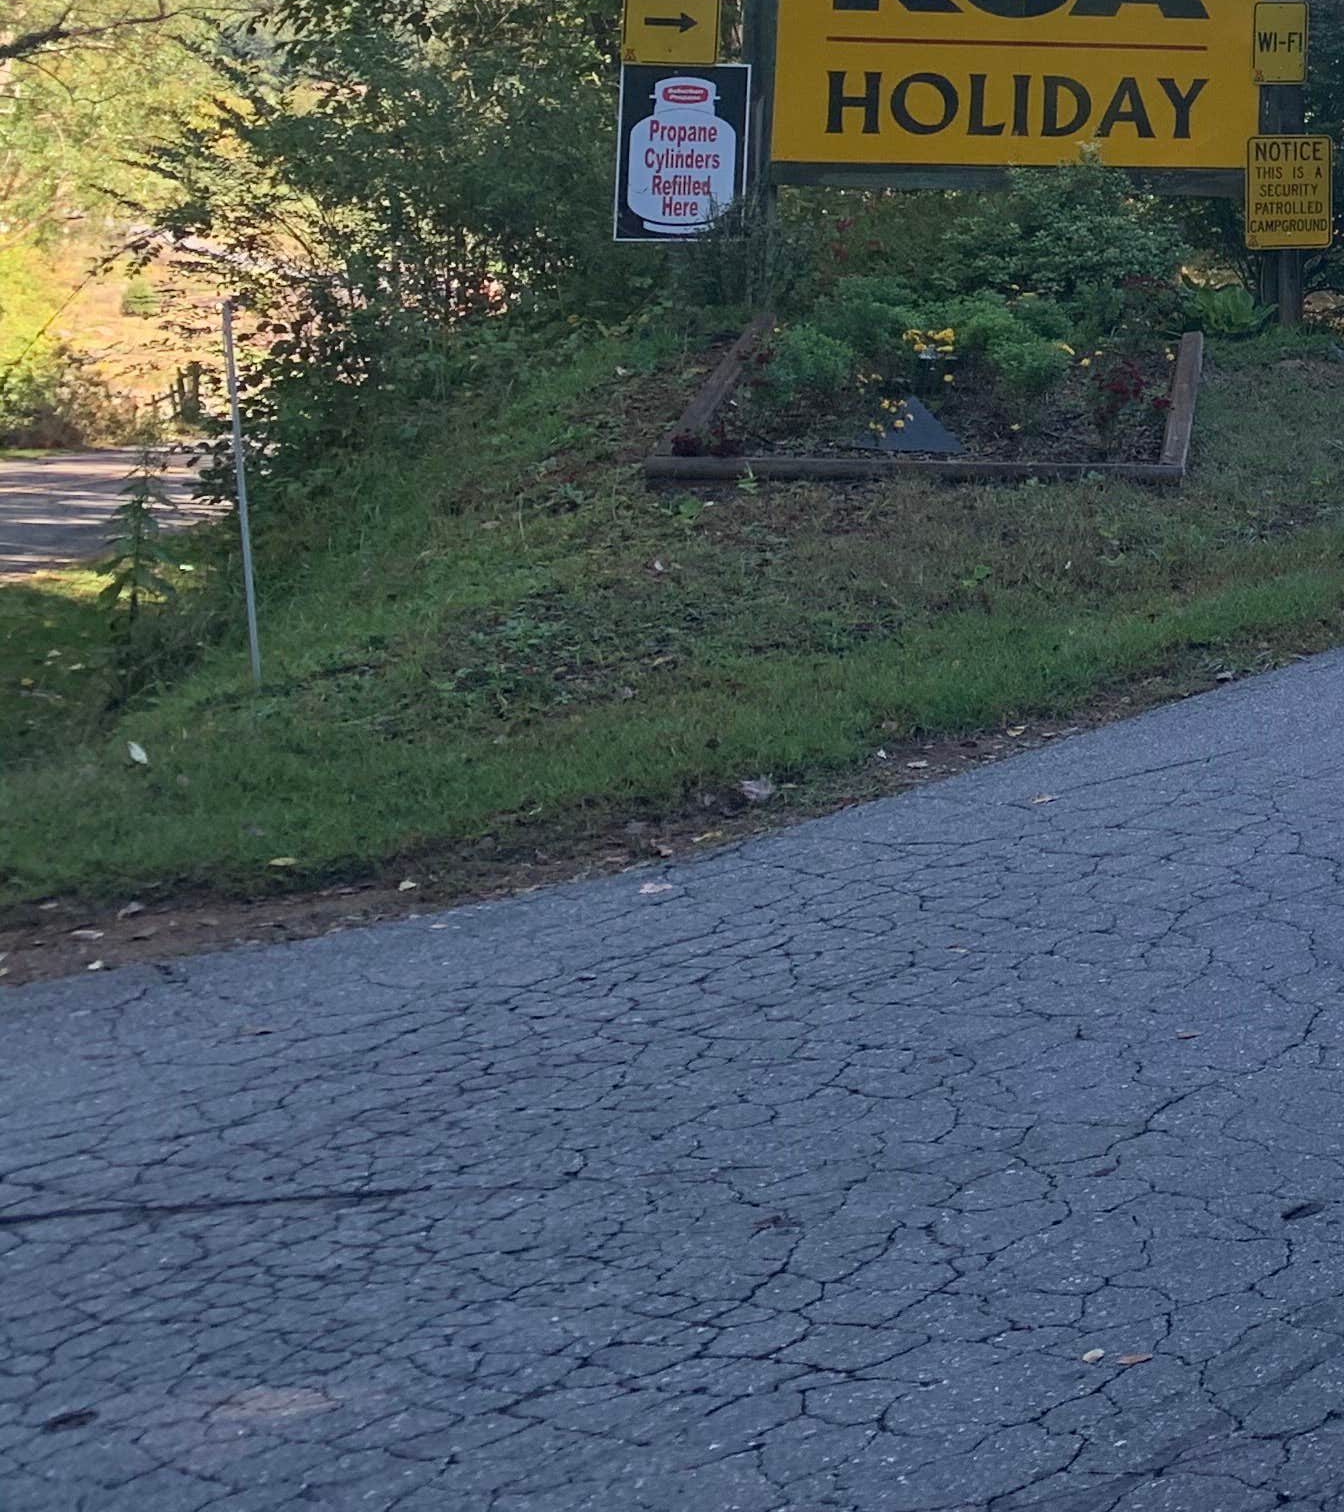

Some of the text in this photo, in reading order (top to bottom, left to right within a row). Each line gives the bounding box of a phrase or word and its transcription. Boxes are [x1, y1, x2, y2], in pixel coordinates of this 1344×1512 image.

[1257, 31, 1303, 53] WI-FI
[825, 70, 1210, 139] HOLIDAY
[649, 119, 718, 148] Propane
[644, 147, 720, 174] Cylinders
[1255, 141, 1323, 162] NOTICE
[1256, 166, 1323, 180] THIS IS A
[651, 175, 711, 196] Refilled
[1259, 183, 1319, 197] SECURITY
[661, 196, 699, 216] Here
[1255, 201, 1323, 215] PATROLLED
[1249, 218, 1328, 233] CAMPGROUND
